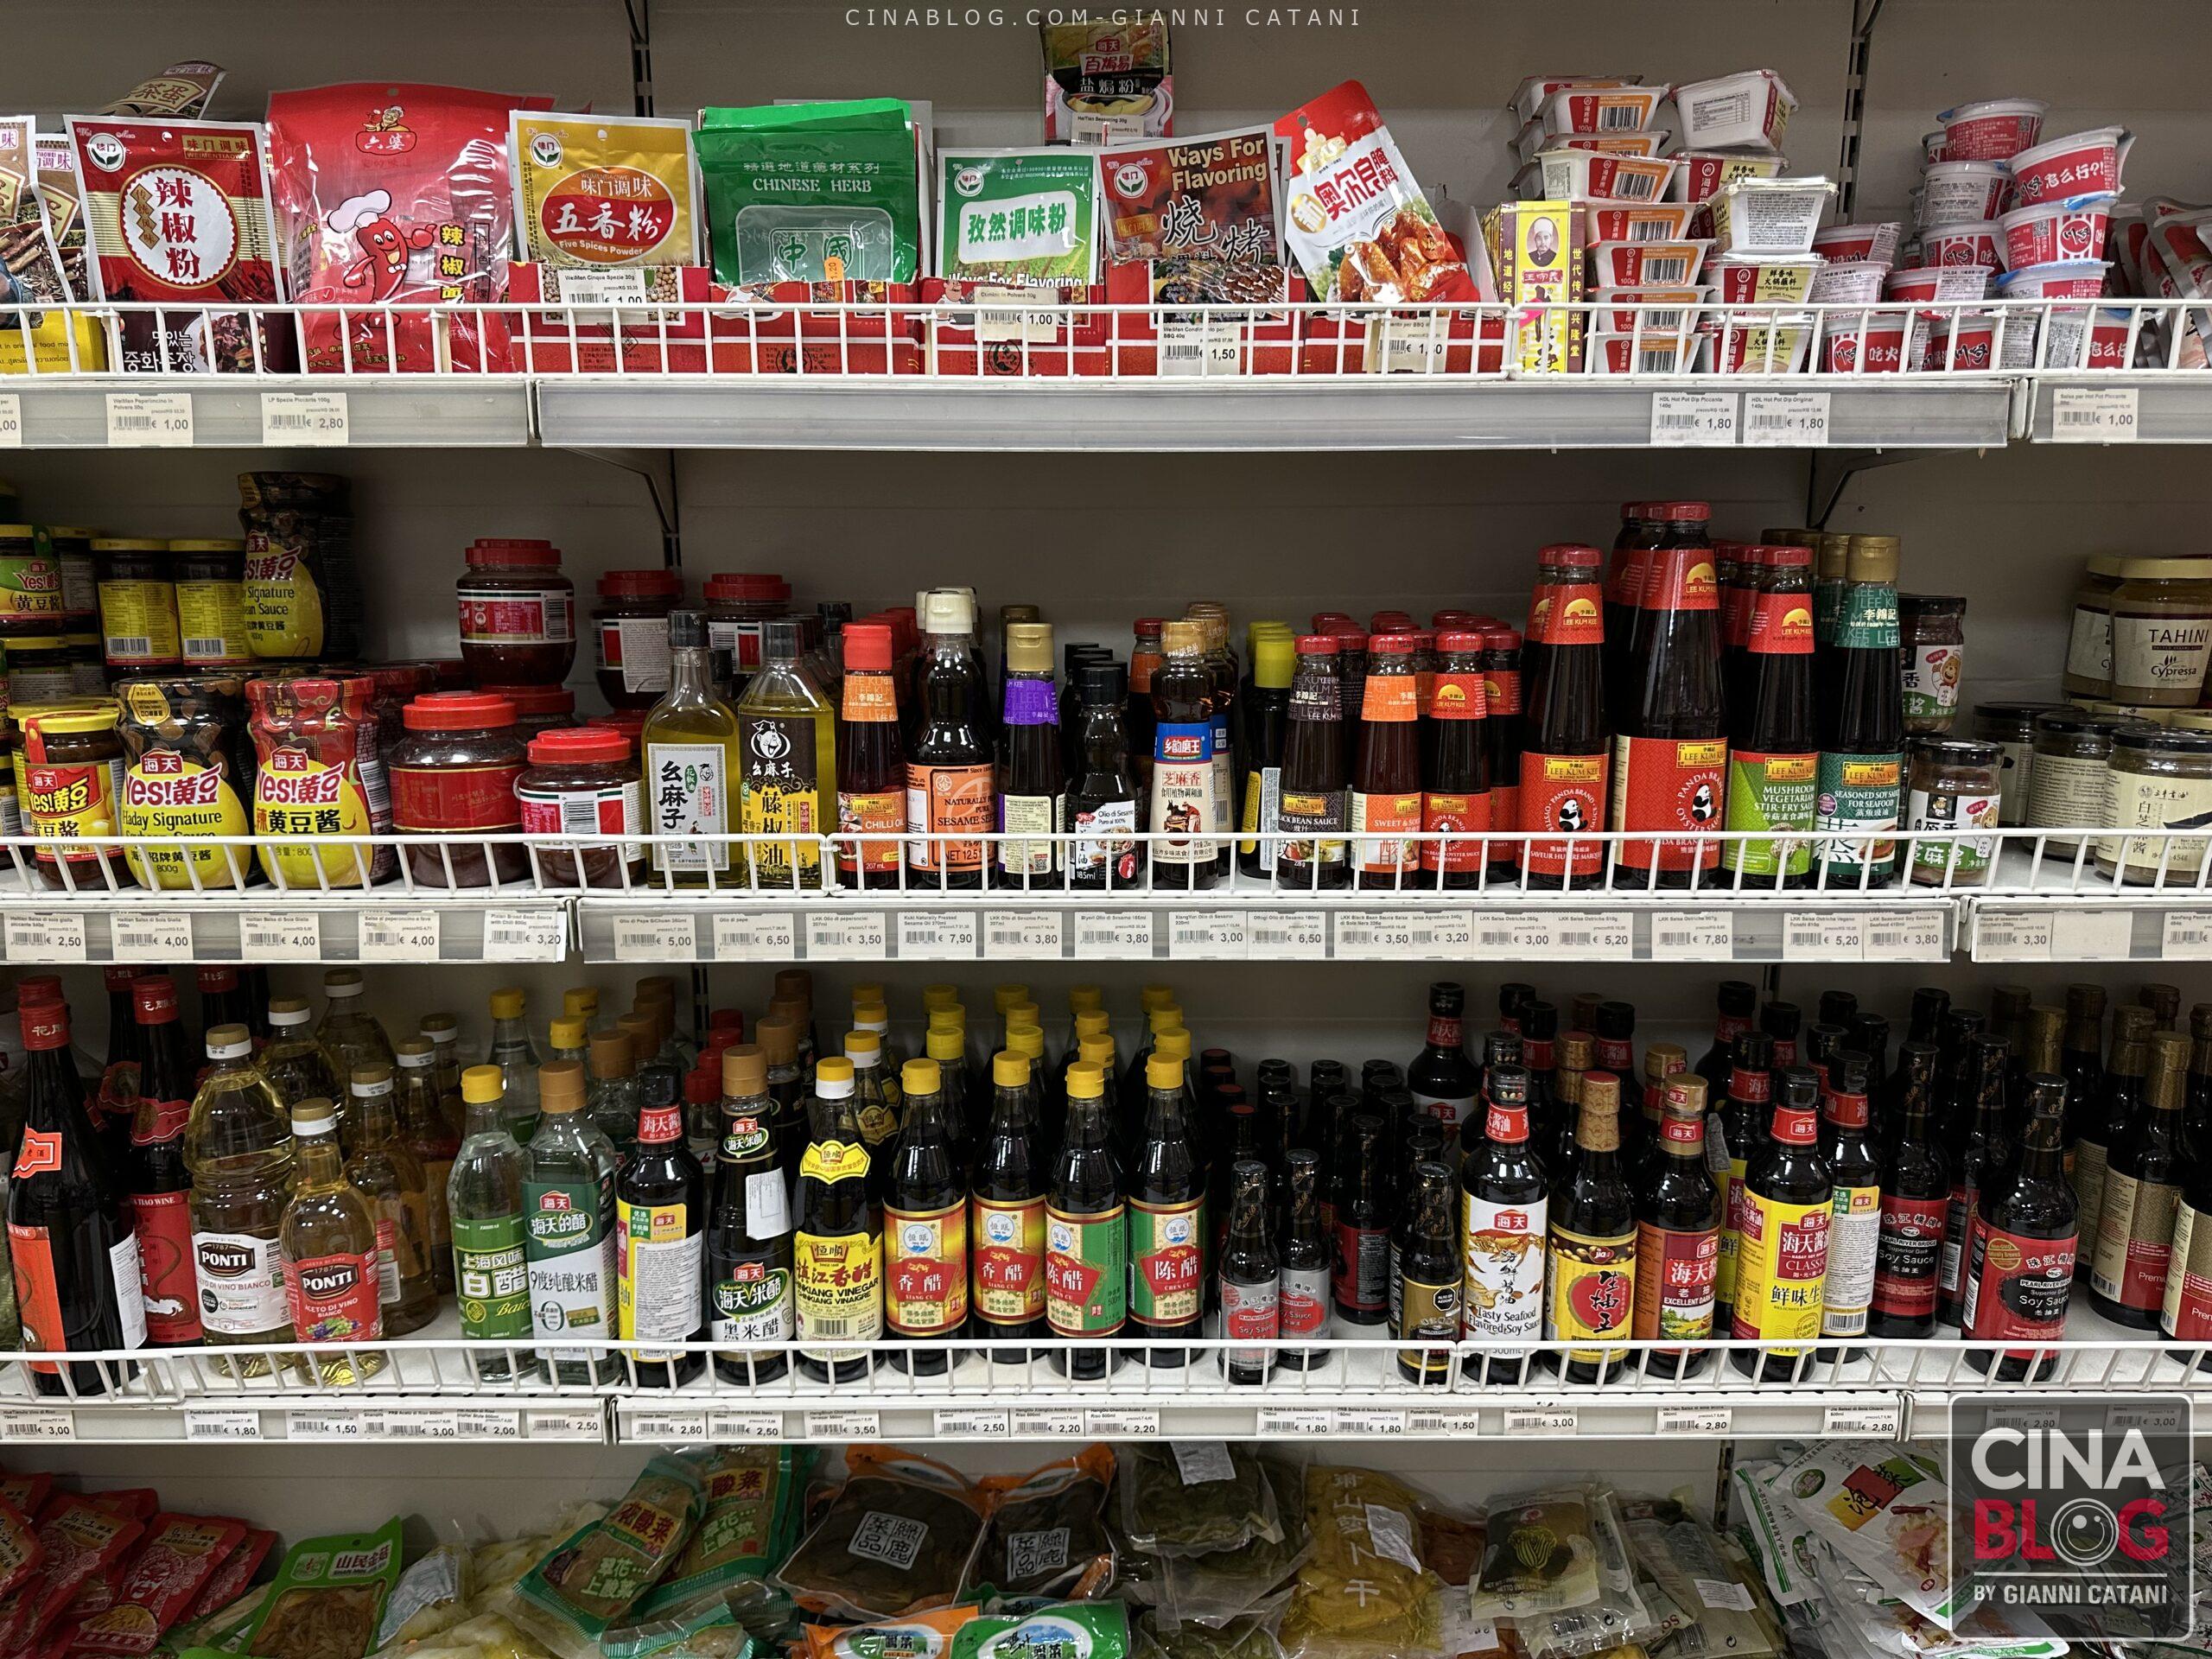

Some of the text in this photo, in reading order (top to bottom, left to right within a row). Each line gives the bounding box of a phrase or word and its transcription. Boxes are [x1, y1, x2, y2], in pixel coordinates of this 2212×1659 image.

[187, 138, 248, 151] 味门调味
[537, 142, 555, 151] 味门
[1166, 137, 1264, 168] Ways For
[1171, 162, 1267, 192] Flavoring
[581, 177, 653, 198] 味门调味
[753, 178, 872, 193] CHINESE HERB
[550, 201, 662, 241] 五香粉
[968, 202, 1068, 244] 孜然调味粉
[155, 176, 200, 279] 辣椒粉
[559, 239, 644, 257] Five Spices Powder
[1029, 315, 1052, 326] 1,00
[1212, 349, 1235, 361] 1,50
[165, 420, 188, 432] 1,00
[319, 418, 343, 430] 2,80
[1707, 418, 1731, 430] 1,80
[1800, 418, 1823, 430] 1,80
[2109, 415, 2133, 427] 1,00
[247, 585, 296, 603] Signature
[258, 602, 289, 616] Sauce
[2148, 629, 2209, 644] TAHINI
[2151, 664, 2197, 679] Cypressa
[143, 758, 177, 772] 海天
[273, 755, 305, 770] 海天
[752, 760, 793, 778] 幺麻子
[1162, 771, 1201, 786] 芝麻香
[658, 760, 689, 829] 幺麻子
[1834, 790, 1880, 799] SEASONED SOY
[944, 797, 986, 806] NATURALLY
[1753, 802, 1798, 811] STIR-FRY
[1848, 799, 1894, 808] FOR SEAFOOD
[122, 810, 223, 831] Haday Signature
[865, 819, 893, 830] CHILLI
[938, 815, 978, 827] SESAME
[1292, 817, 1313, 825] BEAN
[156, 865, 179, 875] 800g
[59, 937, 80, 948] 2,50
[165, 937, 188, 948] 4,00
[293, 937, 315, 948] 4,00
[411, 937, 434, 947] 4,00
[537, 935, 561, 945] 3,20
[669, 937, 691, 948] 5,00
[767, 936, 789, 946] 6,50
[859, 935, 880, 946] 3,50
[950, 934, 972, 944] 7,90
[1035, 935, 1057, 945] 3,80
[1127, 934, 1148, 945] 3,80
[1221, 932, 1243, 944] 3,00
[1299, 934, 1321, 945] 6,50
[1386, 934, 1408, 945] 3,50
[1446, 933, 1468, 944] 3,20
[1526, 936, 1548, 946] 3,00
[1605, 936, 1628, 946] 5,20
[1705, 935, 1727, 946] 7,80
[1836, 936, 1858, 947] 5,20
[1916, 935, 1938, 946] 3,80
[2024, 935, 2046, 946] 3,30
[138, 1197, 175, 1206] TIAO WINE
[543, 1198, 569, 1209] 海天
[531, 1212, 587, 1236] 海天的醋
[1497, 1214, 1526, 1228] 海天
[1803, 1212, 1826, 1229] 海天
[201, 1250, 247, 1267] PONTI
[462, 1248, 524, 1270] 上海风味
[1903, 1254, 1935, 1264] Sauce
[981, 1263, 1023, 1281] 香醋
[1154, 1256, 1199, 1280] 陈醋
[302, 1270, 353, 1290] PONTI
[736, 1270, 762, 1280] 海天
[218, 1282, 237, 1291] VINO
[238, 1280, 271, 1291] BIANCO
[530, 1270, 598, 1293] 9度纯酿米醋
[898, 1274, 942, 1293] 香醋
[836, 1277, 879, 1298] VINEGAR
[718, 1277, 782, 1312] 海天米醋
[835, 1291, 872, 1306] VINAIGRE
[338, 1297, 359, 1308] VINO
[1590, 1270, 1619, 1334] 生抽王
[1663, 1296, 1699, 1306] EXCELLENT
[2018, 1295, 2043, 1308] Soy
[317, 1308, 342, 1318] BIANCO
[1477, 1306, 1536, 1323] Tasty Seafood
[723, 1319, 779, 1341] 黑米醋
[1468, 1316, 1522, 1336] Flavored Soy
[577, 1421, 598, 1432] 2,50
[1453, 1422, 1474, 1431] 1,50
[1553, 1418, 1573, 1428] 3,00
[1706, 1422, 1726, 1431] 2,80
[2033, 1420, 2055, 1429] 2,80
[2154, 1418, 2175, 1427] 3,00
[48, 1427, 69, 1436] 3,00
[235, 1427, 256, 1436] 1,80
[336, 1425, 356, 1434] 1,50
[433, 1428, 454, 1438] 3,00
[494, 1427, 515, 1436] 2,00
[681, 1426, 702, 1435] 2,80
[757, 1427, 778, 1437] 2,50
[855, 1427, 875, 1435] 3,50
[983, 1424, 1004, 1433] 2,50
[1059, 1425, 1080, 1434] 2,20
[1134, 1426, 1154, 1434] 2,20
[1306, 1425, 1326, 1434] 1,80
[1380, 1425, 1401, 1434] 1,80
[1872, 1424, 1894, 1434] 2,80
